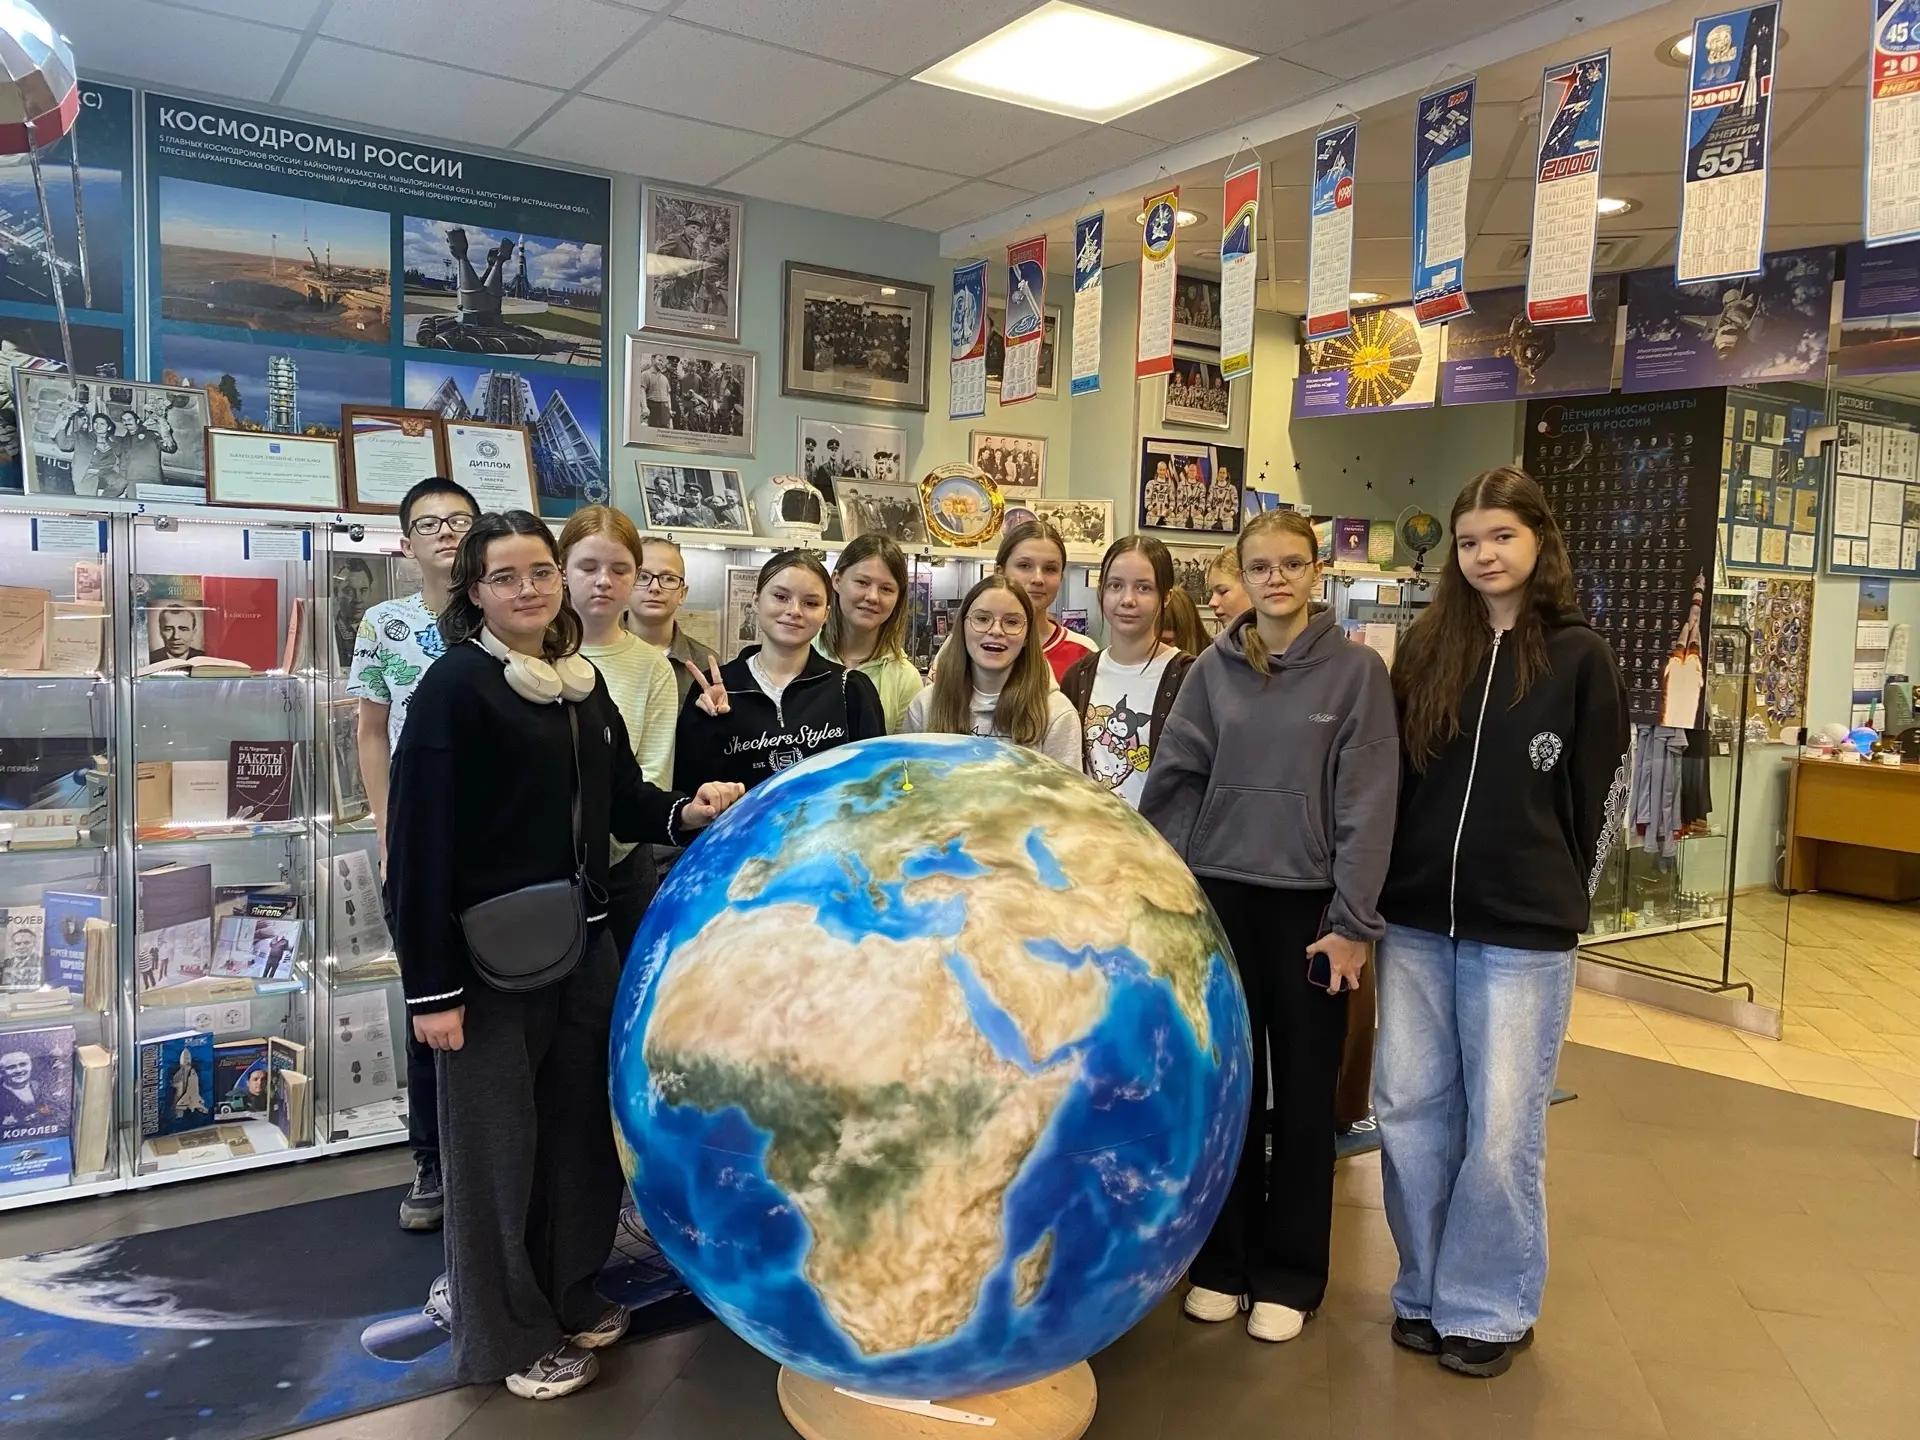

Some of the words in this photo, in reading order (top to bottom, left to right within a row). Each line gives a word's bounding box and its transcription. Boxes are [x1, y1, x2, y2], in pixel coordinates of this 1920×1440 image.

[1886, 22, 1909, 43] 45
[1692, 87, 1739, 107] 2001
[1708, 123, 1760, 141] ЭНЕРГИЯ
[159, 107, 356, 160] КОСМОДРОМЫ
[364, 145, 463, 179] РОССИИ
[1540, 149, 1598, 181] 2000
[1697, 142, 1745, 178] 55
[159, 145, 197, 159] ПЛЕСЕЦК
[198, 152, 263, 170] (АРХАНГЕЛЬСКАЯ
[287, 168, 335, 182] ВОСТОЧНЫЙ
[336, 176, 377, 188] (АМУРСКАЯ
[399, 187, 425, 197] ЯСНЫЙ
[425, 191, 478, 206] (ОРЕНБУРГСКАЯ
[165, 136, 202, 148] ГЛАВНЫХ
[203, 143, 267, 159] КОСМОДРОМОВ
[303, 160, 343, 172] БАЙКОНУР
[389, 175, 455, 192] КЫЗЫЛОРДИНСКАЯ
[476, 190, 511, 202] КАПУСТИН
[1337, 185, 1352, 202] 1998
[1561, 399, 1697, 420] ЛЁТЧИКИ-КОСМОНАВТЫ
[1561, 424, 1589, 434] СССР
[1604, 417, 1651, 430] РОССИИ
[469, 460, 511, 469] ДИПЛОМ
[138, 504, 145, 513] 3
[336, 514, 343, 523] 4
[667, 533, 673, 541] 6
[803, 540, 808, 548] 7
[724, 731, 794, 755] Skechers
[794, 722, 845, 748] Styles
[238, 752, 283, 765] РАКЕТЫ
[752, 761, 766, 769] EST.
[237, 765, 245, 775] И
[247, 764, 282, 778] ЛЮДИ
[24, 814, 89, 827] ОЛЕВ
[8, 915, 43, 925] РОЛЕВ
[251, 907, 282, 917] Янгель
[3, 1124, 59, 1139] КОРОЛЕВ
